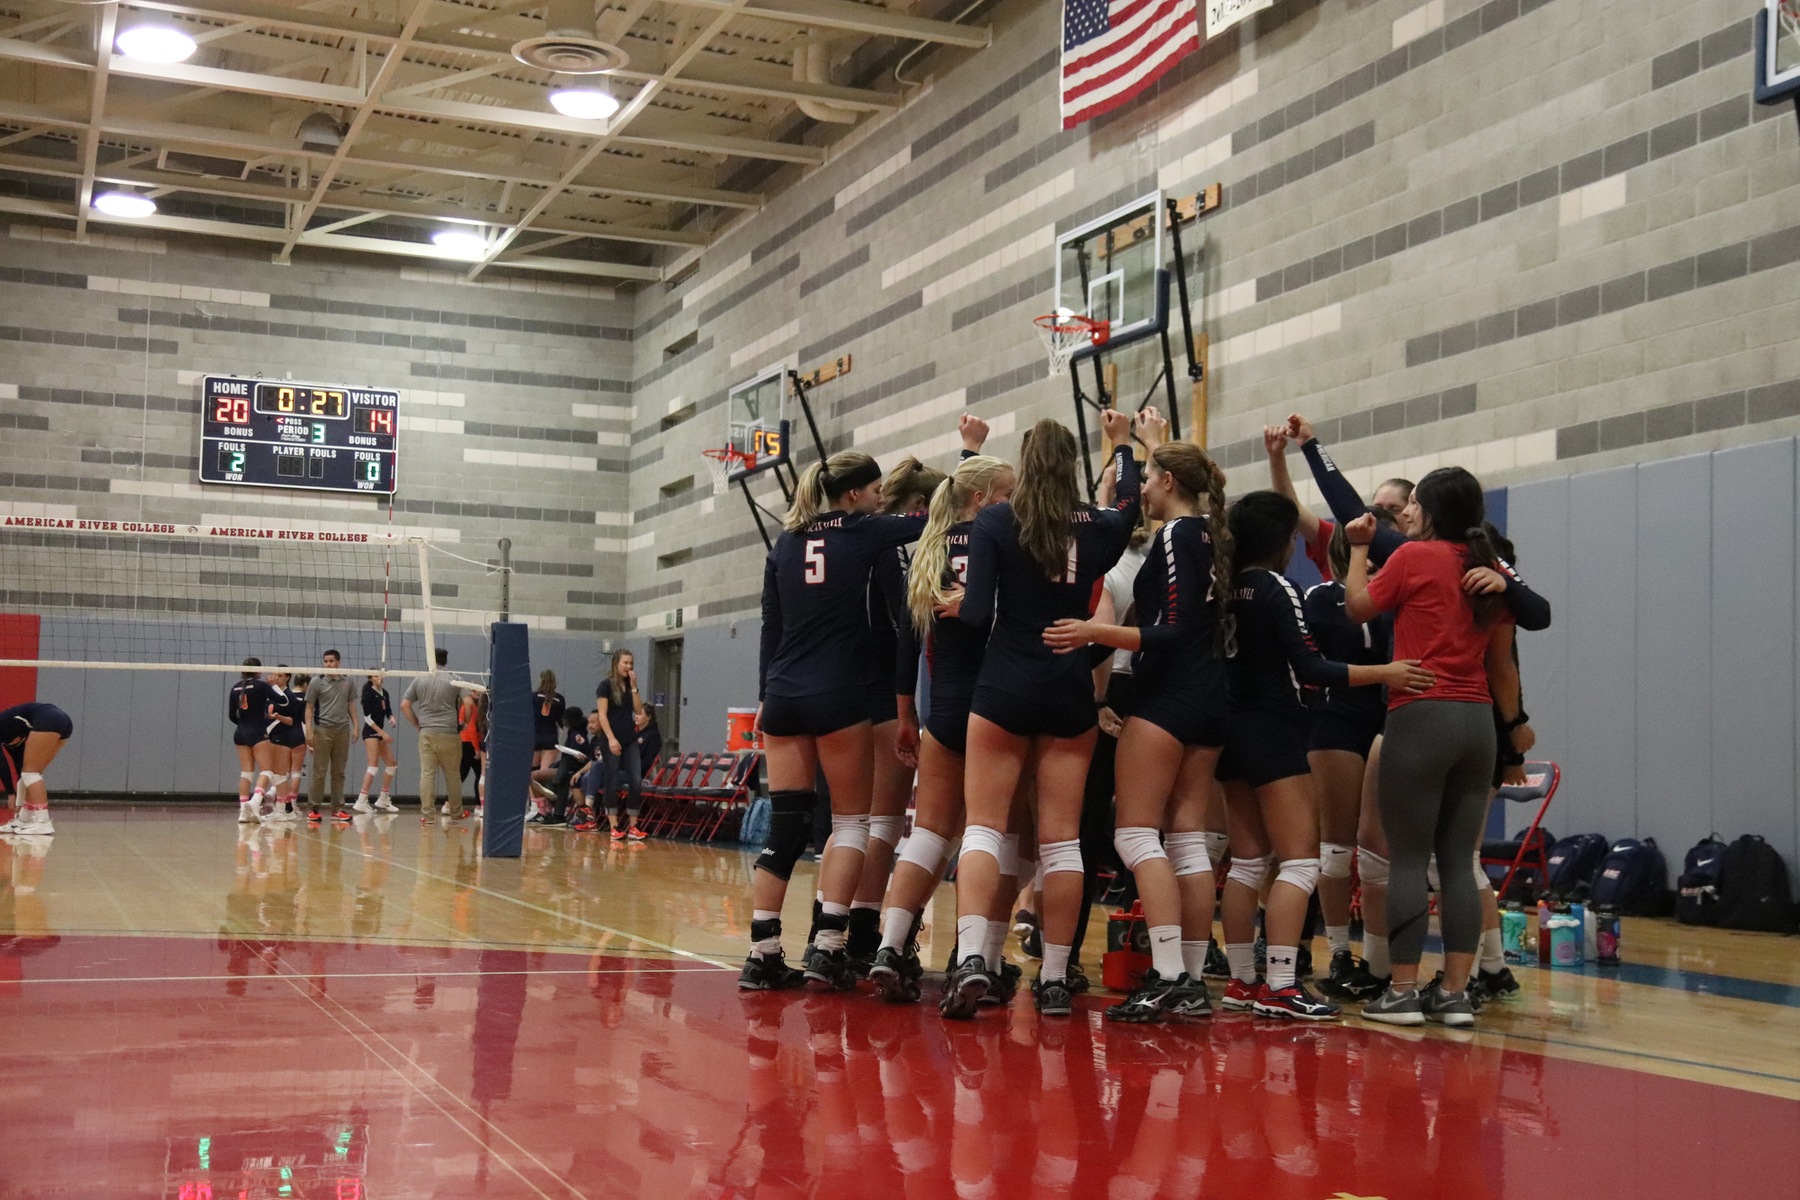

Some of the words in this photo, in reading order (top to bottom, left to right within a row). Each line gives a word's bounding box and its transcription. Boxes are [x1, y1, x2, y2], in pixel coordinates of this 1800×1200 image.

[213, 382, 248, 395] HOME
[278, 388, 343, 416] 0:27
[352, 392, 396, 407] VISITOR
[216, 398, 248, 423] 20
[284, 418, 302, 426] POSS
[371, 410, 391, 434] 14
[223, 427, 254, 437] BONUS
[277, 425, 309, 436] PERIOD
[313, 423, 325, 443] 3
[218, 442, 246, 452] FOULS
[349, 436, 377, 446] BONUS
[272, 446, 304, 456] PLAYER
[310, 448, 337, 458] FOULS
[354, 452, 381, 462] FOULS
[230, 453, 245, 472] 2
[225, 473, 243, 481] WON
[367, 462, 380, 481] 0
[357, 482, 375, 490] WON
[5, 517, 74, 528] AMERICAN
[79, 520, 118, 531] RIVER
[122, 523, 175, 534] COLLEGE
[210, 527, 273, 538] AMERICAN
[278, 530, 314, 540] RIVER
[318, 532, 368, 543] COLLEGE
[804, 538, 826, 585] 5
